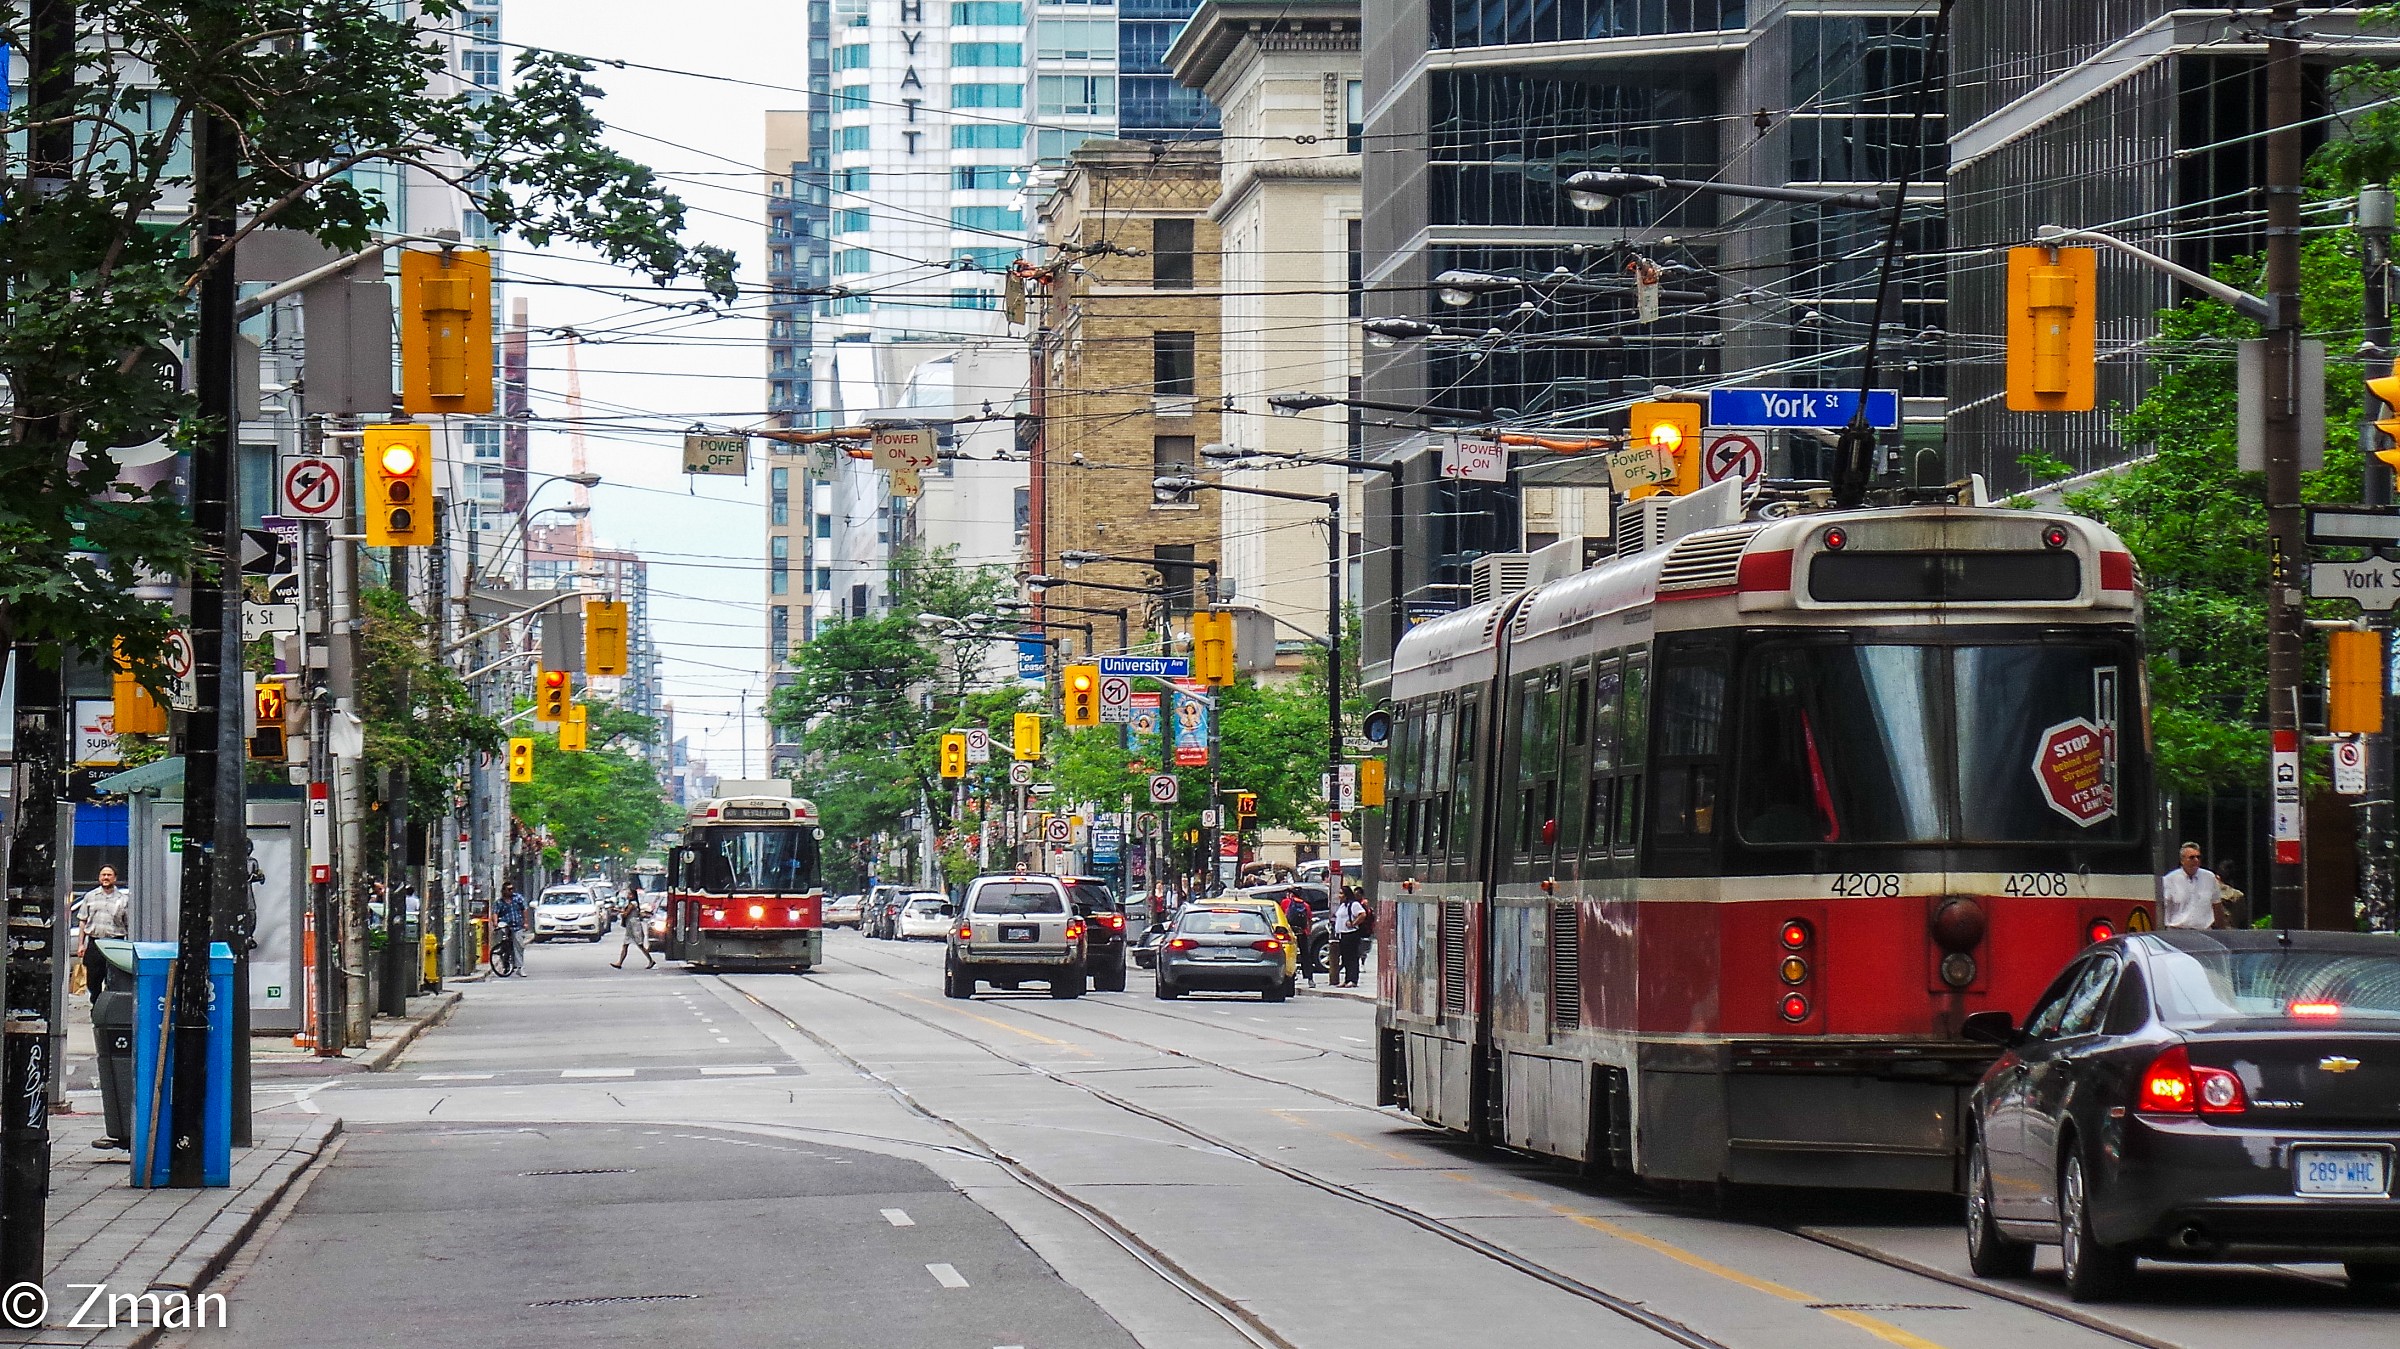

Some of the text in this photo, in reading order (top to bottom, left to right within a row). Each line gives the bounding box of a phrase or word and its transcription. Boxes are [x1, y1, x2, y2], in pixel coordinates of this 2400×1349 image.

[901, 0, 922, 155] HYATT
[1761, 393, 1839, 418] York St
[700, 440, 744, 452] POWER
[876, 434, 919, 445] POWER
[889, 448, 906, 459] ON
[1461, 443, 1503, 457] POWER
[708, 454, 735, 465] OFF
[1472, 458, 1490, 469] ON
[1611, 449, 1654, 468] POWER
[1625, 465, 1647, 479] OFF
[2343, 569, 2384, 588] York
[260, 610, 274, 625] St
[1019, 652, 1035, 662] For
[1019, 662, 1045, 672] Lease
[1104, 658, 1167, 675] University
[2053, 734, 2091, 758] STOP
[2052, 756, 2082, 773] behind
[88, 770, 97, 778] St
[2074, 776, 2097, 790] doors
[2071, 783, 2104, 804] IT'S TH
[1831, 872, 2068, 898] 4208 4208
[269, 987, 280, 997] TD
[2309, 1161, 2375, 1182] 289 WHC
